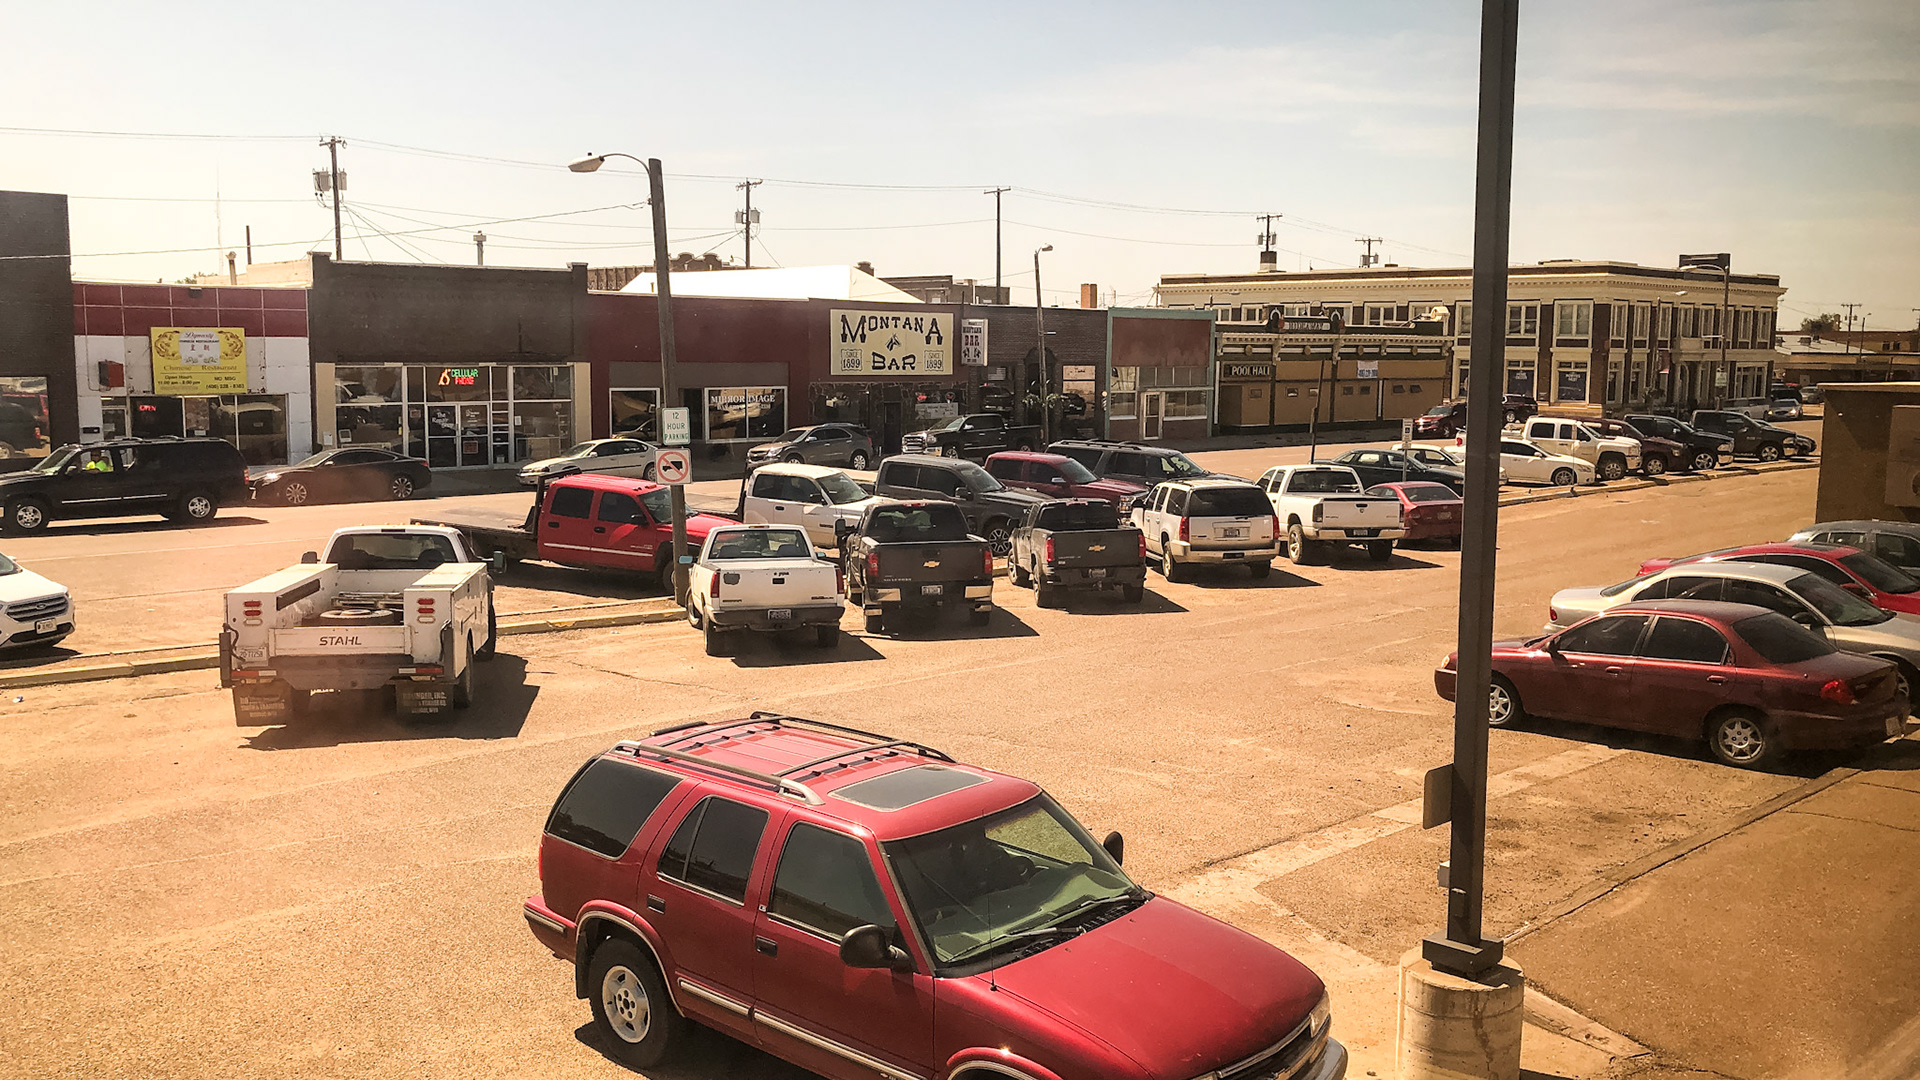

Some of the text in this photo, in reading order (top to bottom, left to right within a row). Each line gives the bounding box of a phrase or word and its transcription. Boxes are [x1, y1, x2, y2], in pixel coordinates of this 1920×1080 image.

[840, 314, 943, 345] MONTANA
[965, 335, 979, 346] BAR
[843, 358, 861, 369] 1899
[871, 351, 916, 370] BAR
[926, 359, 942, 369] 1899
[451, 368, 478, 377] CELLULAR
[455, 376, 475, 384] PHONE
[710, 394, 775, 403] MIRROR IMAGE
[672, 412, 680, 420] 12
[667, 422, 685, 430] HOUR
[319, 636, 362, 646] STAHL
